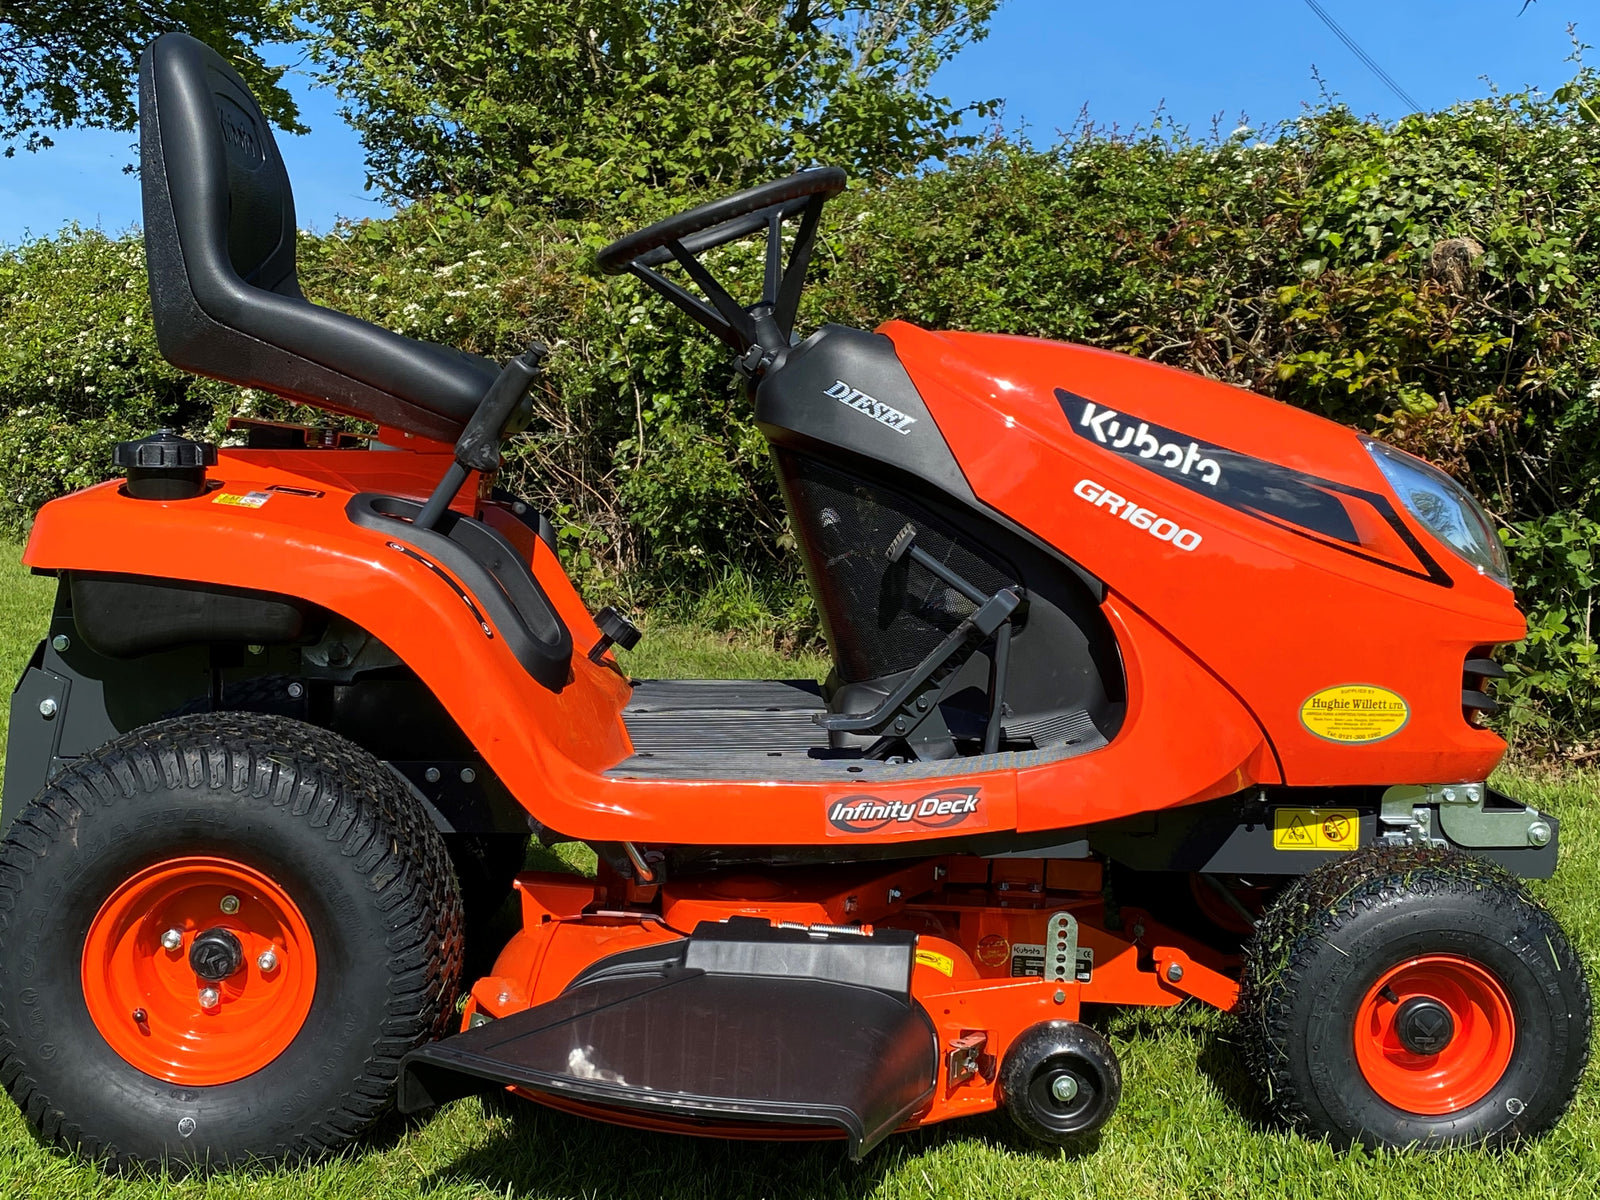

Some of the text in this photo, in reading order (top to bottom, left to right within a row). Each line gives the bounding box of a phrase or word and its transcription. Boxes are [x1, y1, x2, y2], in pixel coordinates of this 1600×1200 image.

[823, 379, 918, 436] DIESEL
[1079, 401, 1222, 486] Kubota
[1073, 479, 1203, 552] GR1600
[1312, 698, 1350, 711] Hughie
[1353, 698, 1387, 710] Willett
[830, 795, 979, 822] Infinity Deck
[1013, 945, 1041, 955] Kubota
